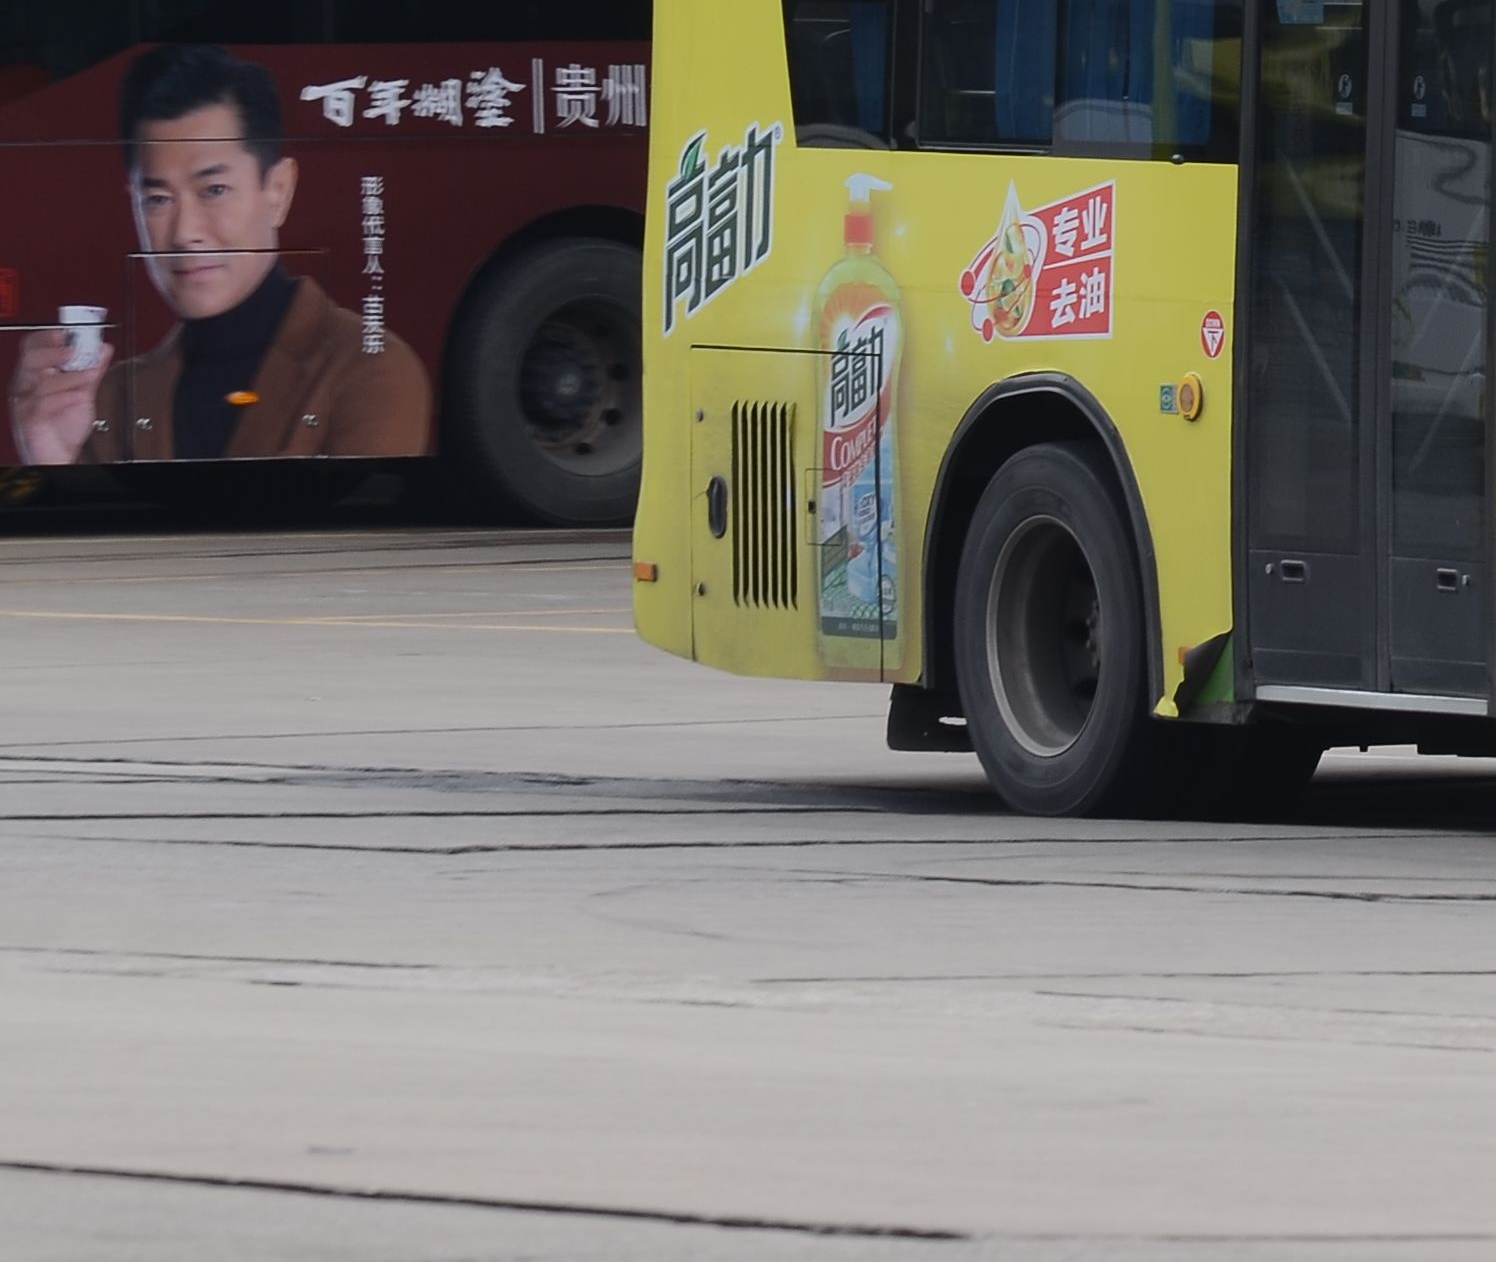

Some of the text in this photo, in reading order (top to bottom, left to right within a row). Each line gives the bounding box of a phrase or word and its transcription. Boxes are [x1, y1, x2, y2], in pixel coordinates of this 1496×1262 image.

[551, 64, 647, 128] 贵州
[1053, 196, 1107, 257] 专业
[1051, 266, 1106, 329] 去油
[1207, 330, 1218, 351] 下
